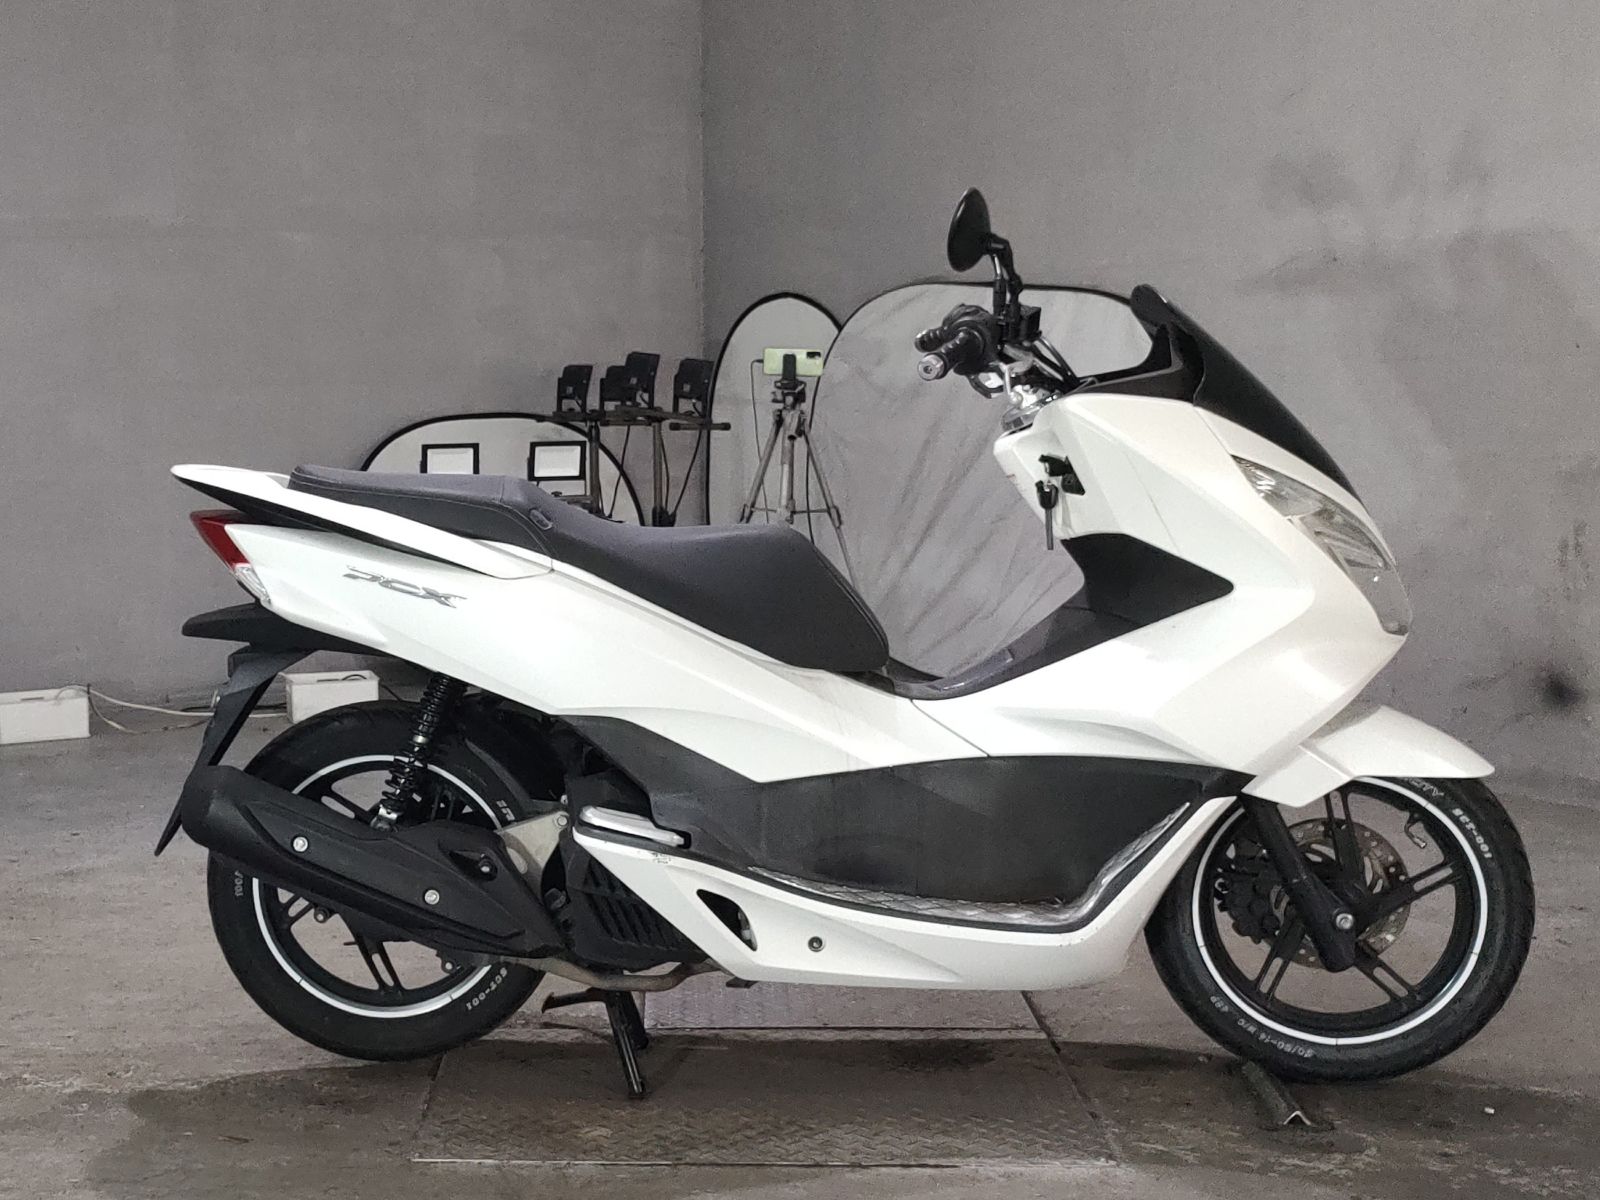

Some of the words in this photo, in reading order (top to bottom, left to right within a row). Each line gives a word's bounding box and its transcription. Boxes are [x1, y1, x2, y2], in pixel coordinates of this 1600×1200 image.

[342, 565, 468, 609] PCX
[1452, 808, 1493, 859] SCT-001
[466, 967, 508, 1010] SCT-001
